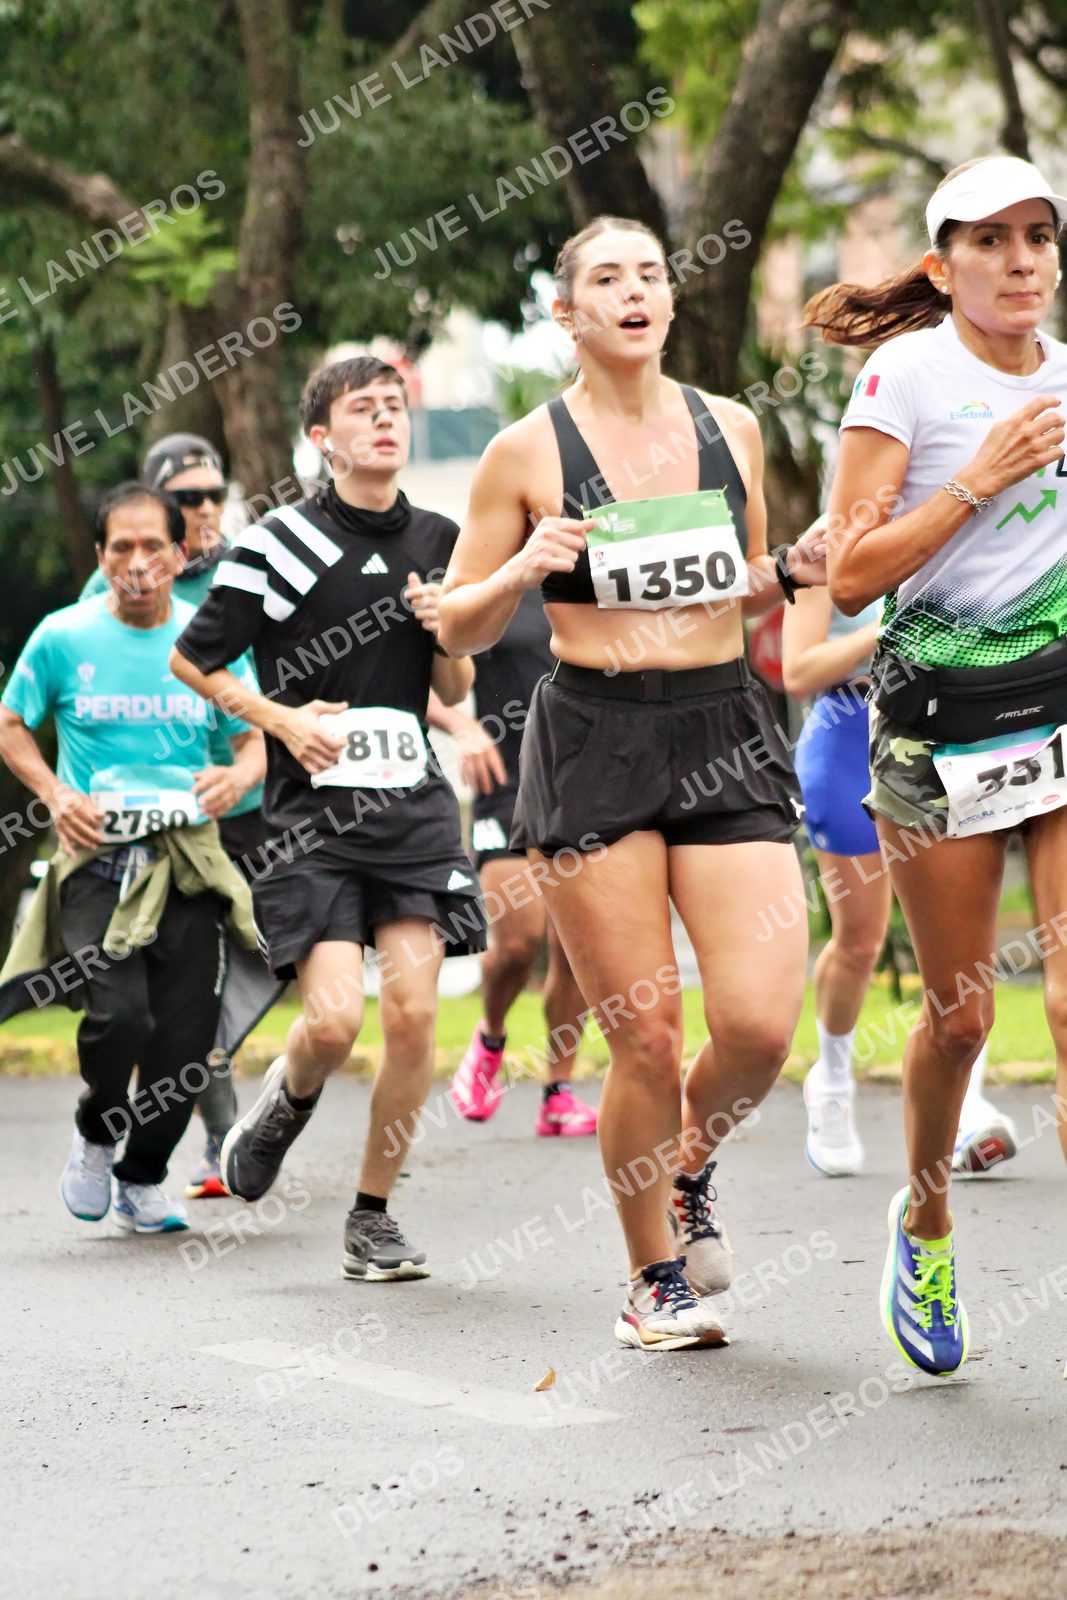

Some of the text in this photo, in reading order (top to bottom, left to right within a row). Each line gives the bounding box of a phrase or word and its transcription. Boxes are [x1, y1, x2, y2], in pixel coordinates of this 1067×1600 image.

[608, 551, 736, 602] 1350
[347, 730, 418, 761] 818
[104, 809, 189, 835] 2780
